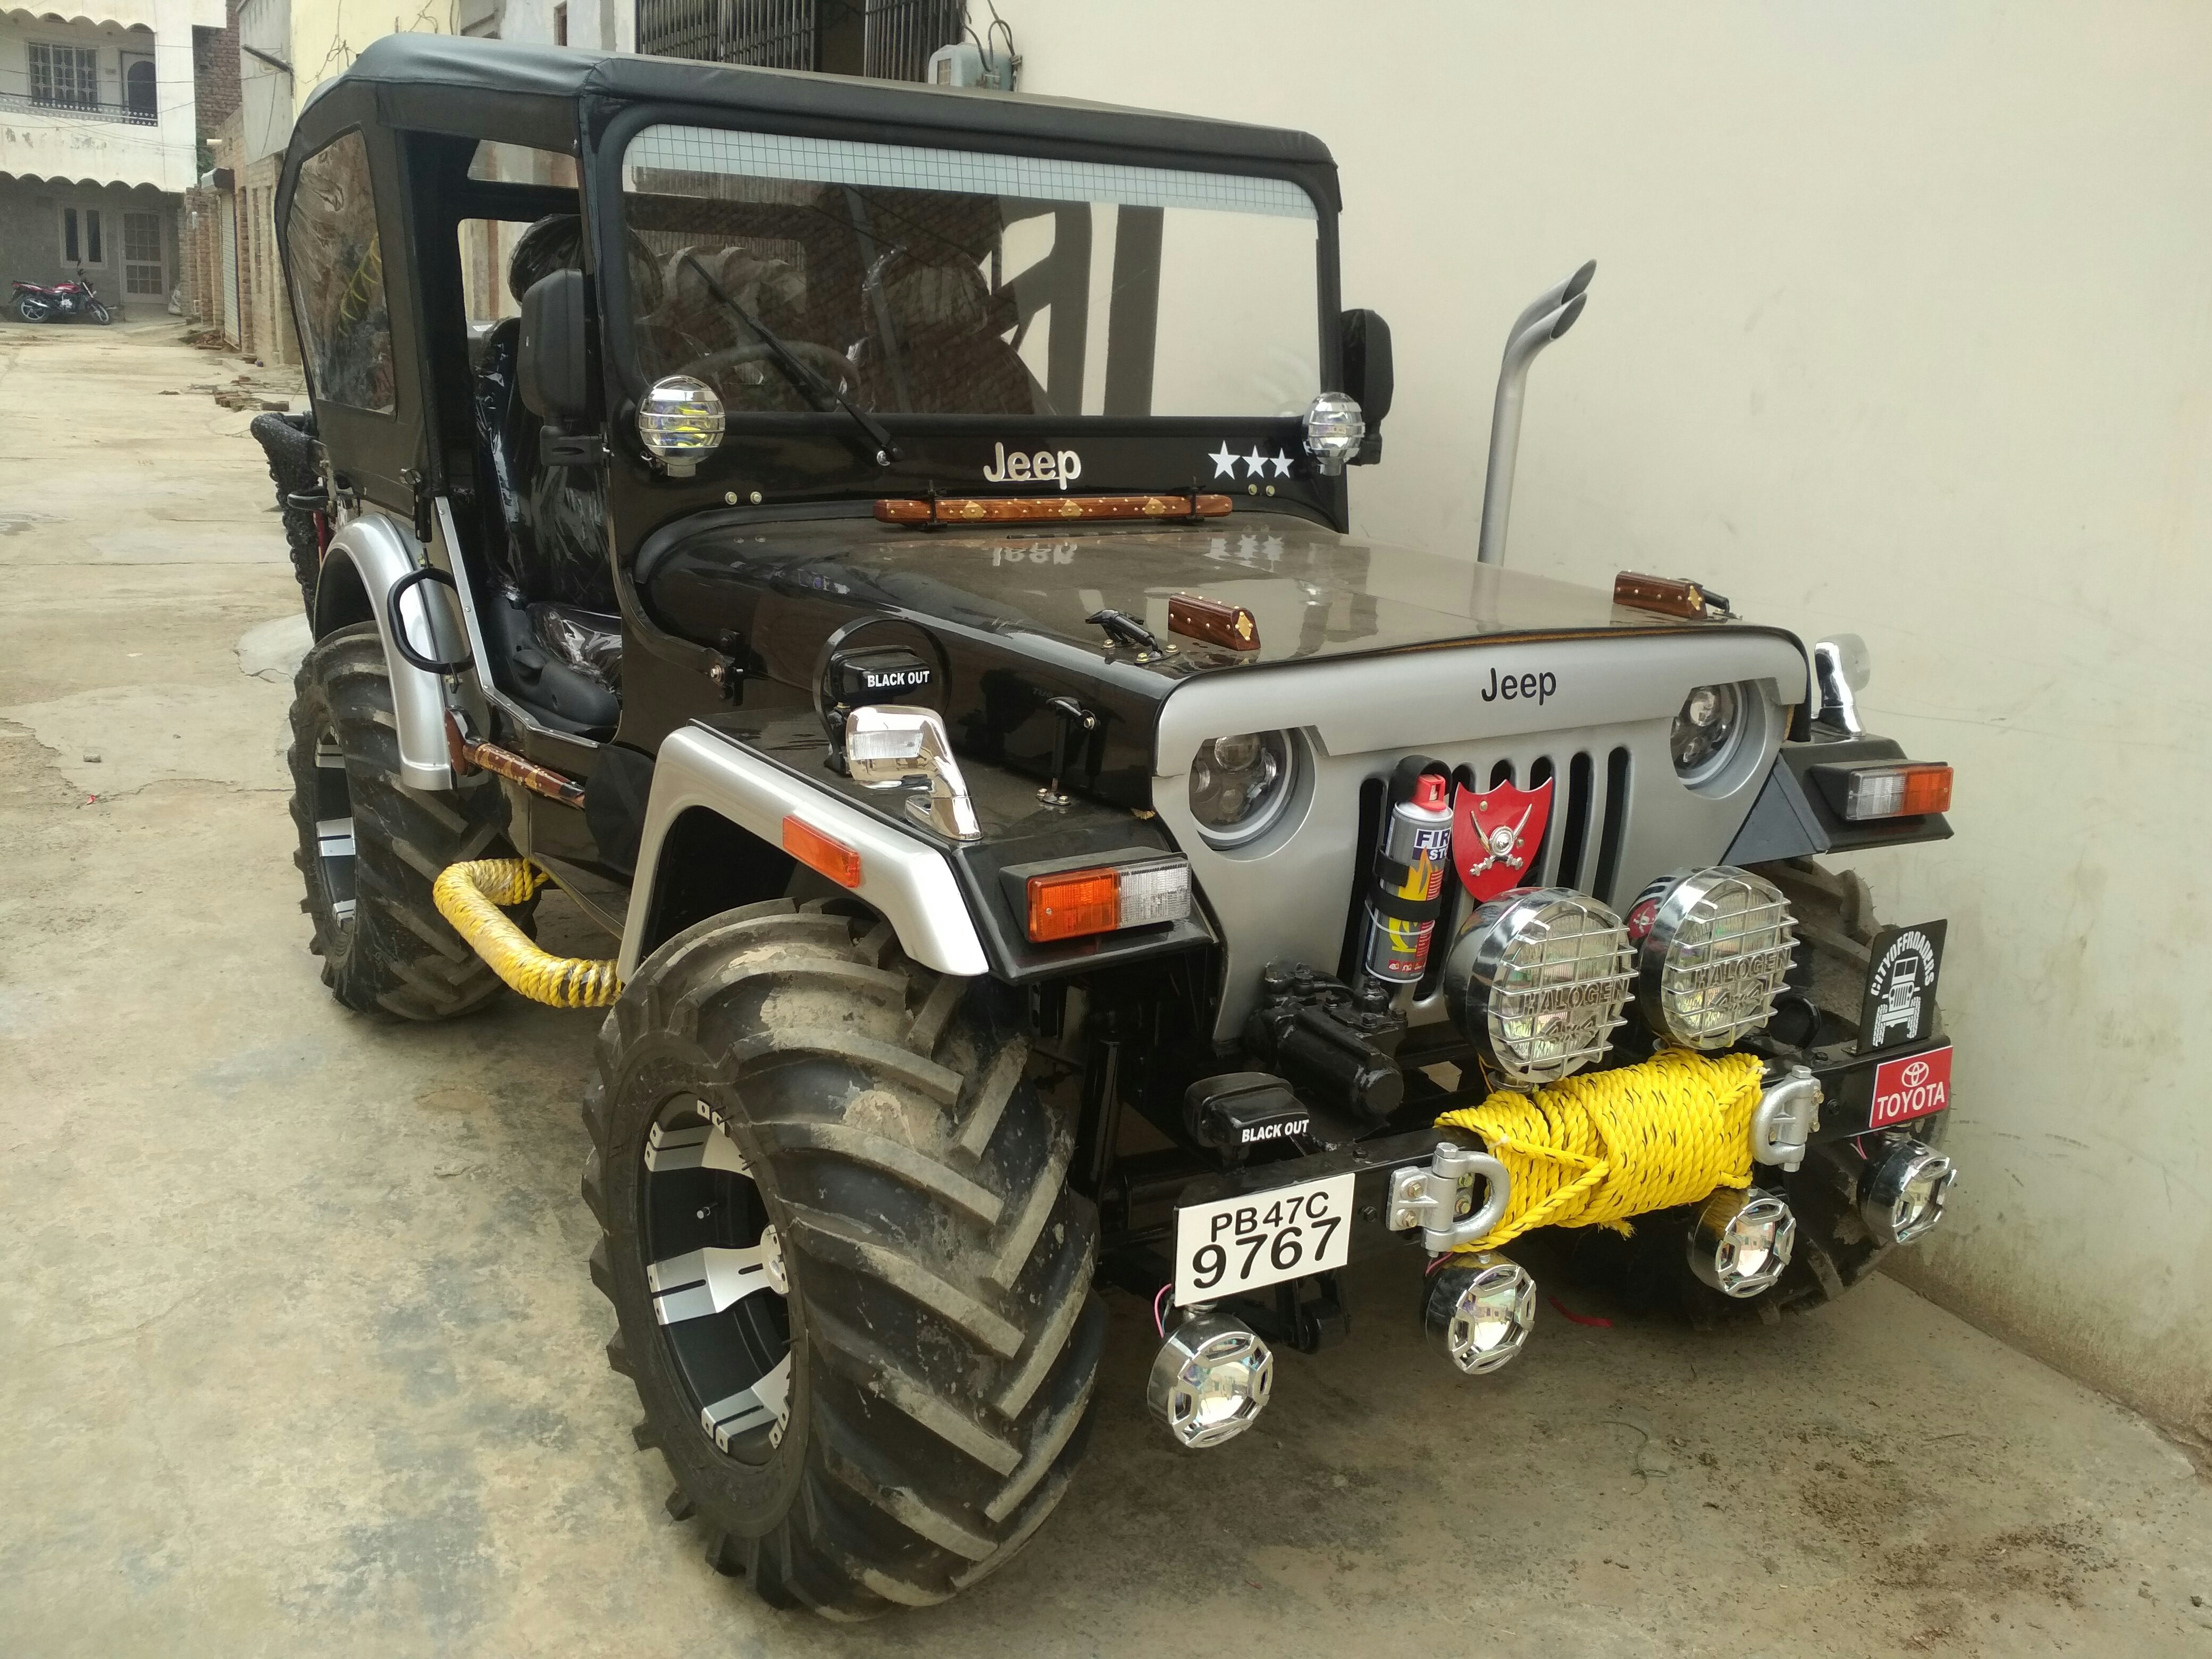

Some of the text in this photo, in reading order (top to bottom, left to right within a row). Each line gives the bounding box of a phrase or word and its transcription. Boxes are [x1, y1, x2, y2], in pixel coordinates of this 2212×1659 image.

[984, 442, 1082, 490] Jeep
[867, 671, 930, 688] BLACK OUT
[1481, 667, 1556, 706] Jeep
[1692, 947, 1791, 989] HALOGEN
[1519, 978, 1630, 1016] HALOGEN
[1877, 1081, 1945, 1120] TOYOTA
[1242, 1119, 1309, 1143] BLACK OUT
[1211, 1191, 1329, 1243] PB47C
[1192, 1216, 1342, 1289] 9767
